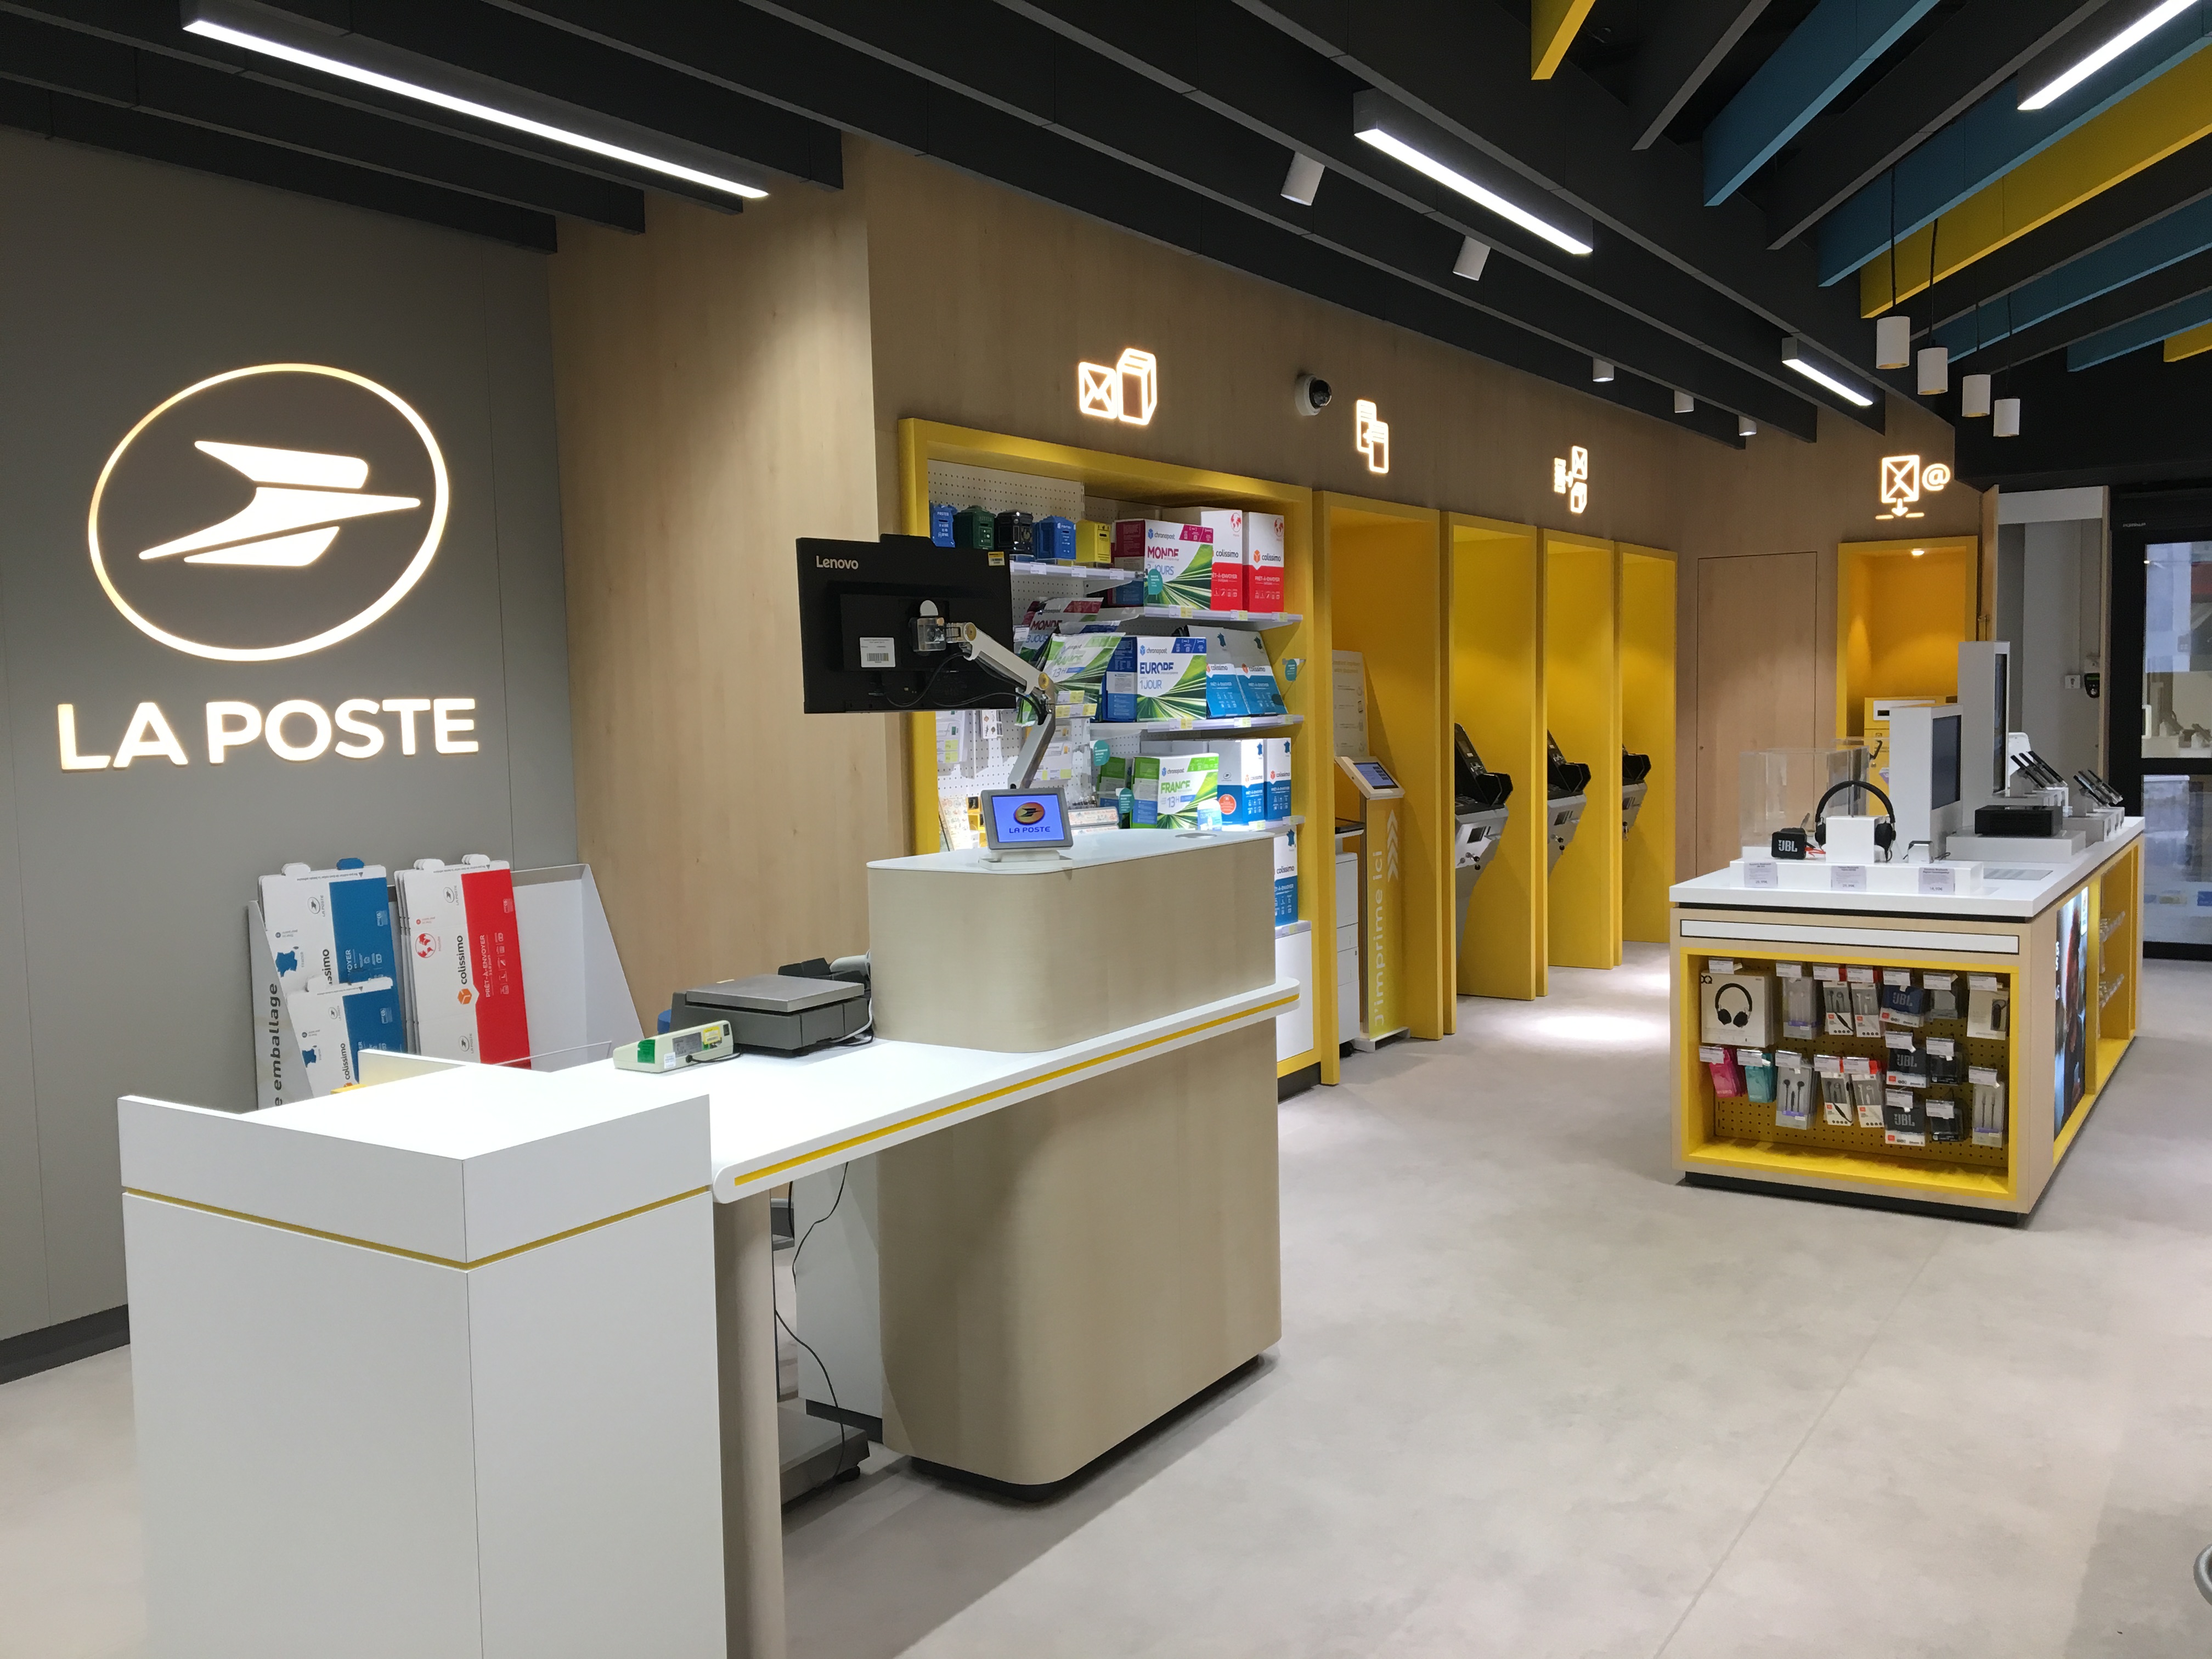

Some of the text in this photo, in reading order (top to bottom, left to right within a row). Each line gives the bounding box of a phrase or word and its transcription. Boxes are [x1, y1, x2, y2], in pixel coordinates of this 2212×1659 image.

[1154, 531, 1175, 540] chronopost
[1147, 546, 1179, 560] MONDE
[1216, 549, 1239, 558] colissimo
[1262, 553, 1281, 562] colissimo
[816, 555, 859, 569] Lenovo
[1140, 662, 1174, 674] EUROPE
[1144, 680, 1162, 690] JOUR
[57, 698, 479, 771] LA POSTE
[1160, 780, 1190, 794] FRANCE
[1778, 839, 1798, 853] JBL
[1276, 865, 1295, 874] colissimo
[1373, 851, 1386, 1026] J'imprime ici
[456, 935, 467, 985] colissimo
[479, 934, 491, 997] PRÊT-À-ENVOYER
[1893, 992, 1913, 1007] JBL
[268, 983, 282, 1091] emballage
[340, 1043, 351, 1080] colissimo
[1897, 1054, 1917, 1068] JBL
[1894, 1114, 1916, 1127] JBL
